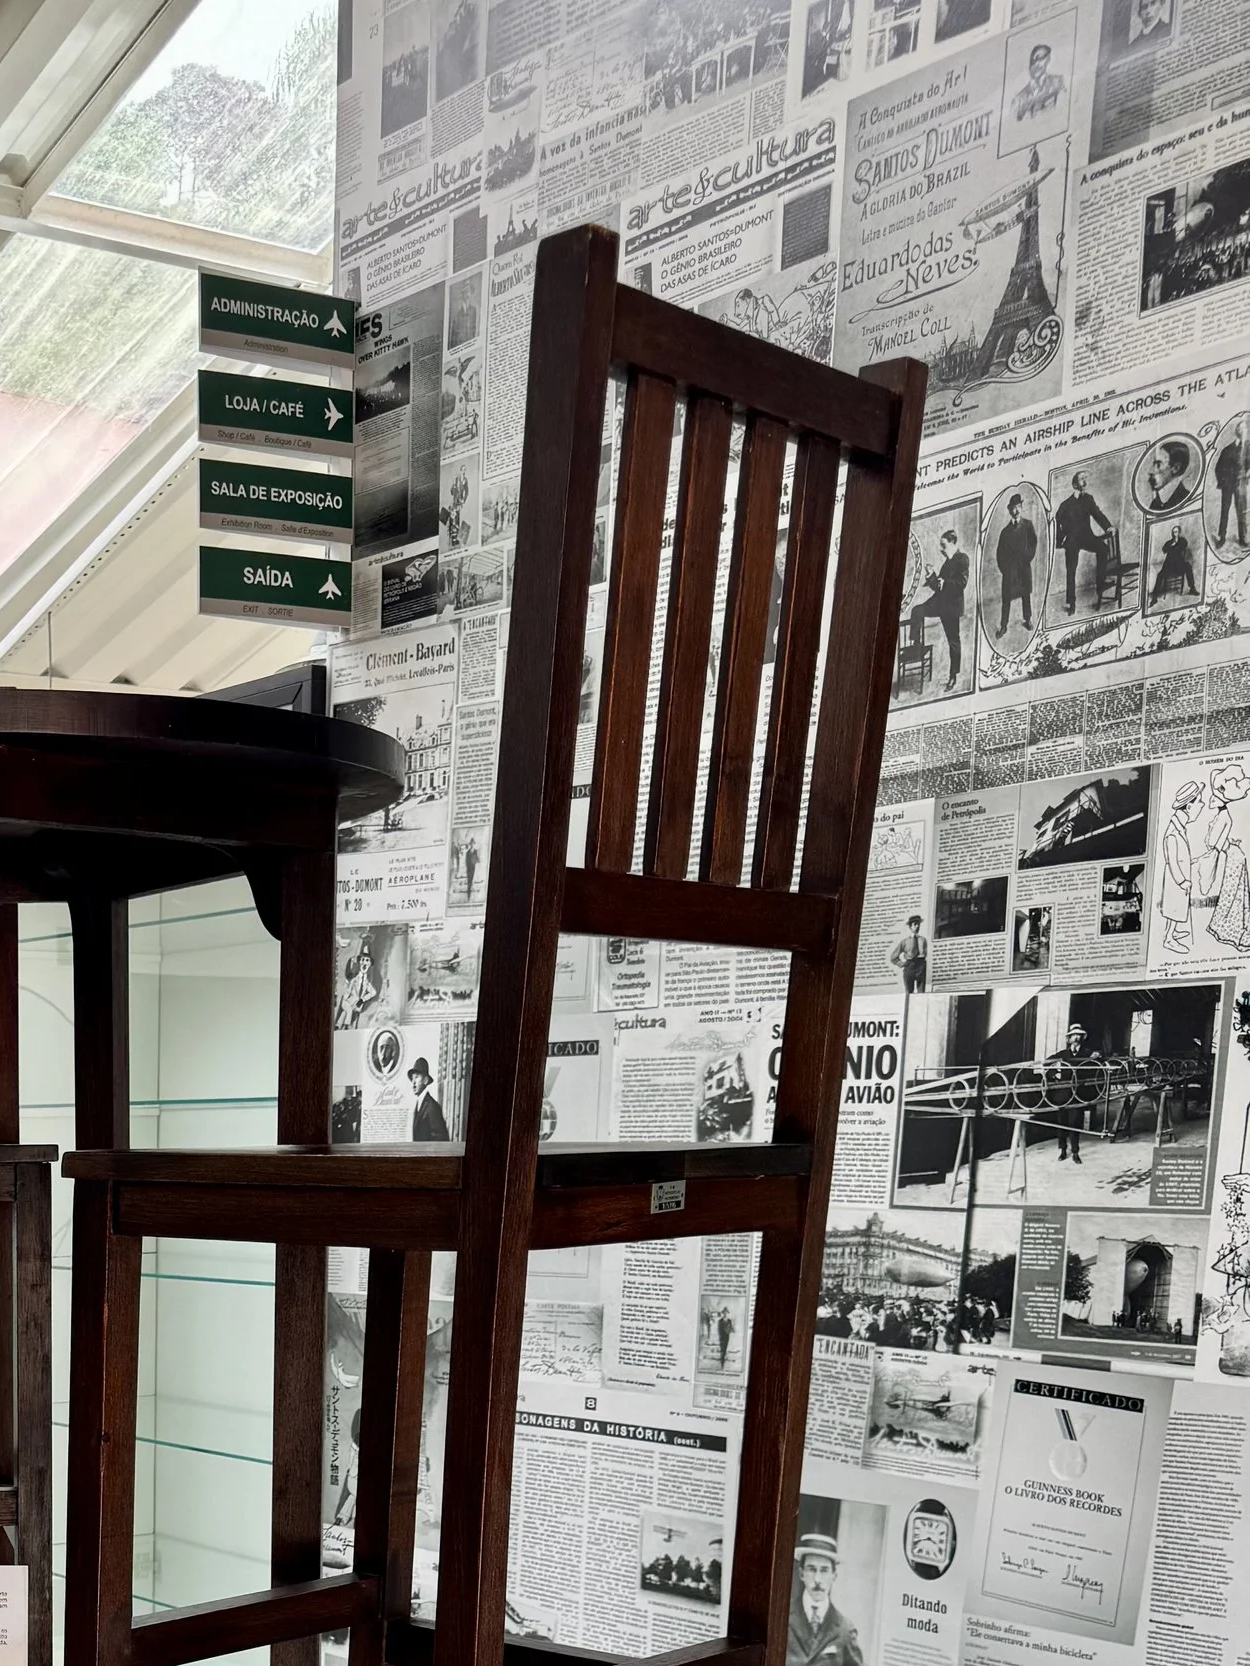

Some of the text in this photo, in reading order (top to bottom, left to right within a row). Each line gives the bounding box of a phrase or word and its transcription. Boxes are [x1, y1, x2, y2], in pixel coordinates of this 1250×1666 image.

[870, 84, 940, 126] Conquista do
[550, 142, 566, 157] voz
[570, 132, 581, 148] da
[1080, 173, 1089, 186] A
[1089, 157, 1134, 182] conquista
[1136, 148, 1149, 160] do
[1188, 128, 1205, 141] seu
[1207, 125, 1213, 133] e
[1216, 116, 1228, 130] da
[852, 110, 993, 204] SANTOS DUMONT
[870, 162, 971, 216] GLORIA DO BRAZIL
[367, 250, 392, 269] ALBERTO
[661, 245, 696, 267] ALBERTO
[661, 238, 743, 280] O GÊNIO BRASILEIRO
[841, 231, 954, 293] Eduardo das
[660, 254, 737, 293] DAS ASAS DE ÍCARO
[211, 297, 319, 328] ADMINISTRAÇÃO
[862, 304, 934, 337] Transcripção de
[243, 339, 288, 353] Administration
[868, 317, 951, 362] MANOEL COLL
[225, 395, 260, 412] LOJA
[270, 400, 304, 418] CAFÉ
[936, 445, 994, 472] PREDICTS
[1000, 438, 1017, 452] AN
[1024, 420, 1074, 445] AIRSHIP
[1080, 409, 1110, 428] LINE
[1116, 391, 1171, 417] ACROSS
[1178, 378, 1207, 397] THE
[218, 430, 312, 448] Shop Café Boutique Café
[947, 472, 959, 481] the
[963, 464, 985, 476] World
[998, 448, 1042, 466] Participate
[1054, 440, 1067, 449] the
[1071, 425, 1106, 445] Benefits
[1108, 423, 1117, 432] of
[1121, 417, 1136, 428] His
[1138, 404, 1187, 424] Inventions.
[211, 481, 342, 510] SALA DE EXPOSIÇÃO
[222, 518, 252, 528] Exhibition
[254, 522, 272, 530] Room
[281, 524, 297, 533] Salle
[243, 565, 293, 588] SAÍDA
[243, 605, 293, 617] EXIT SORTIE
[942, 800, 978, 810] O encanto
[892, 811, 904, 823] pai
[388, 873, 435, 884] AÉROPLANE
[354, 899, 362, 912] 20
[844, 1083, 895, 1104] AVIÃO
[587, 1399, 596, 1409] 8
[1016, 1380, 1142, 1411] CERTIFICADO
[584, 1419, 599, 1433] DA
[607, 1422, 666, 1443] HISTÓRIA
[1005, 1486, 1122, 1517] O LIVRO DOS RECORDES
[1024, 1480, 1104, 1503] GUINNESS BOOK
[902, 1593, 947, 1615] Ditando
[907, 1617, 939, 1634] moda
[967, 1618, 1031, 1638] Sobrinho afirma:
[966, 1628, 982, 1637] "Ele
[984, 1632, 1023, 1647] consertava
[1032, 1641, 1058, 1654] minha
[1059, 1646, 1097, 1661] bicicleta"
